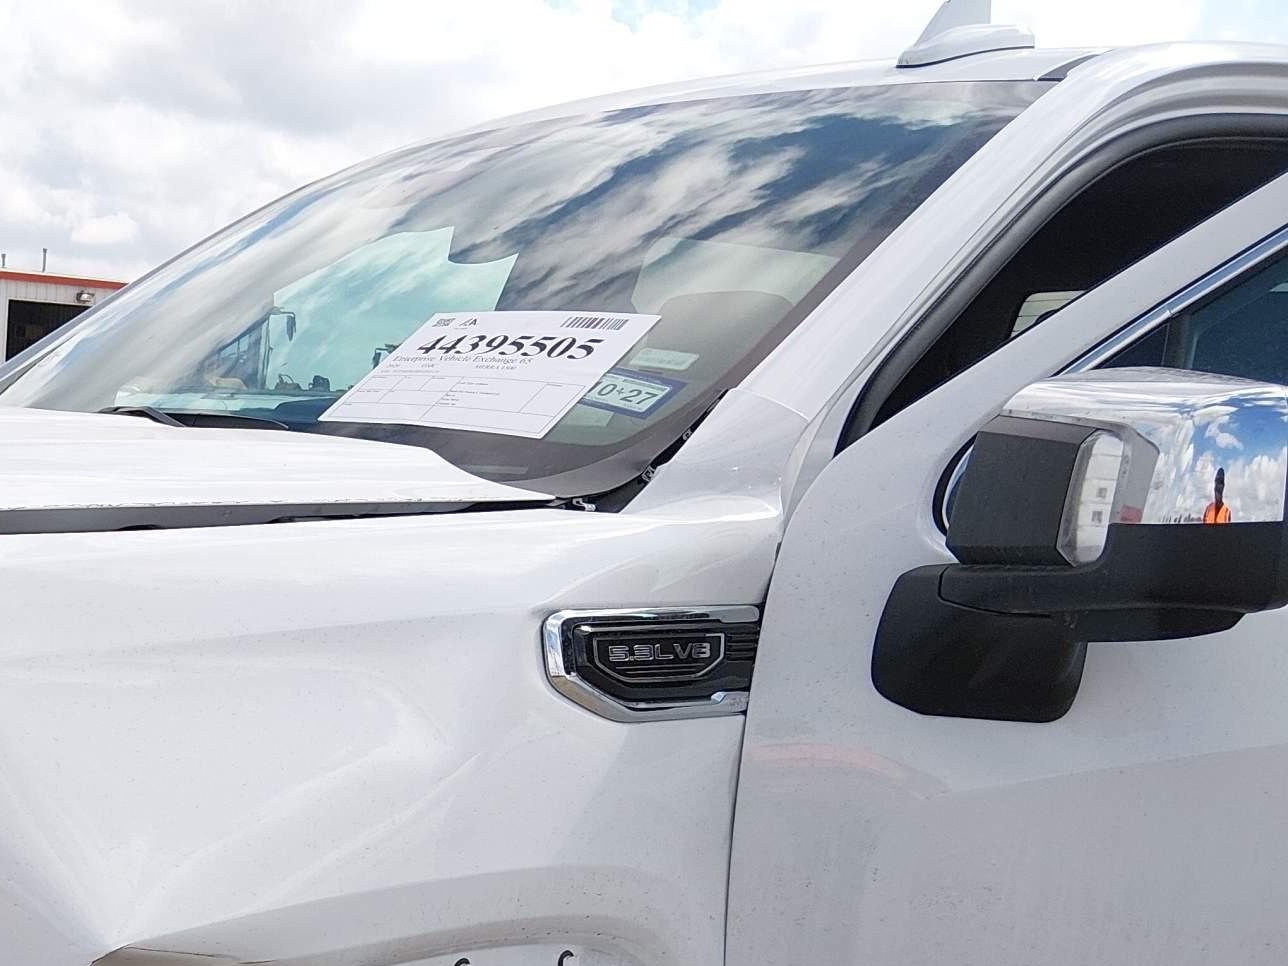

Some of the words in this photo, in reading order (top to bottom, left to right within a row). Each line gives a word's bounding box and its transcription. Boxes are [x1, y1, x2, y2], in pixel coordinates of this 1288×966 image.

[417, 334, 605, 360] 44395505
[439, 354, 469, 363] Vehicle
[472, 356, 517, 365] Exchange
